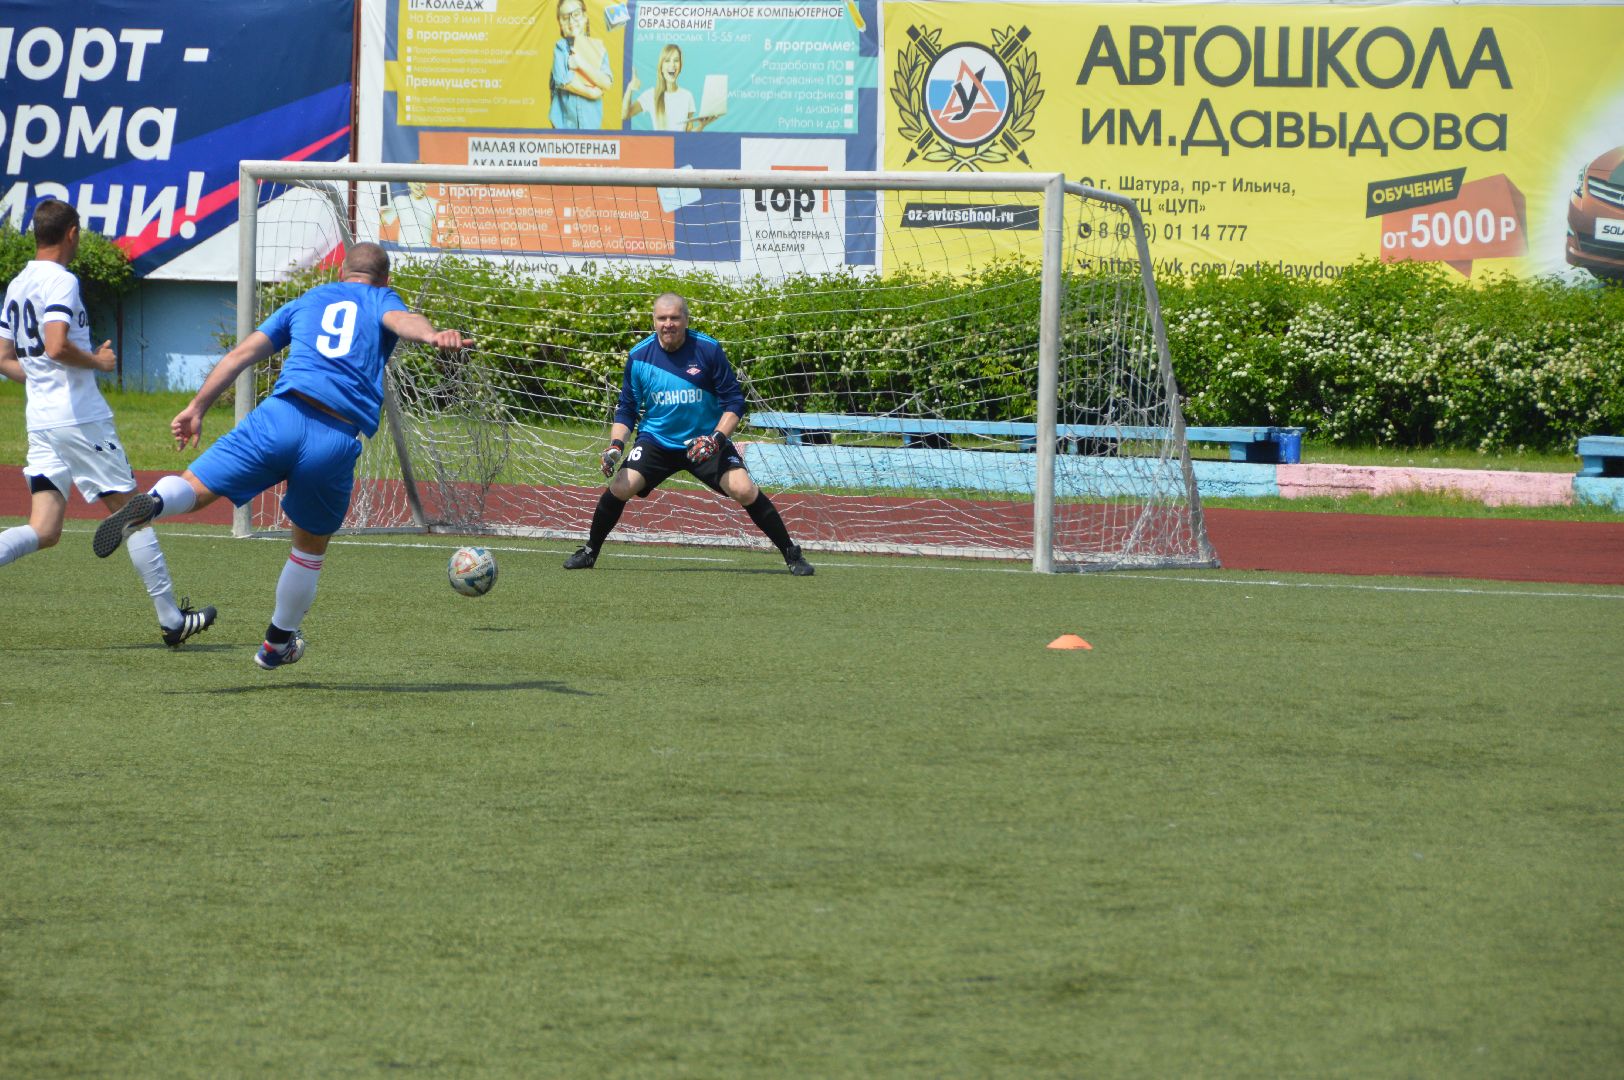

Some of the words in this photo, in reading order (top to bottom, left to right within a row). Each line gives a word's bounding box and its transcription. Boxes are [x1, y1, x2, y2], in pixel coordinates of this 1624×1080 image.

[484, 13, 494, 25] 11
[639, 6, 753, 17] ПРОФЕССИОНАЛЬНОЕ
[757, 7, 844, 18] КОМПЬЮТЕРНОЕ
[638, 19, 713, 29] ОБРАЗОВАНИЕ
[406, 28, 413, 40] В
[416, 30, 488, 43] программе:
[707, 32, 733, 42] 15-55
[764, 38, 771, 51] В
[775, 41, 855, 54] программе:
[1076, 25, 1513, 89] АВТОШКОЛА
[762, 59, 824, 72] Разработка
[827, 60, 844, 70] ПО
[406, 75, 502, 91] Преимущества:
[752, 74, 824, 86] Тестирование
[827, 75, 844, 85] ПО
[796, 89, 844, 102] графика
[805, 104, 843, 114] дизайн
[778, 116, 813, 129] Python
[1082, 98, 1508, 157] им.Давыдова
[0, 104, 177, 175] рма
[472, 141, 516, 153] МАЛАЯ
[519, 142, 617, 155] КОМПЬЮТЕРНАЯ
[450, 185, 528, 200] программе:
[1100, 179, 1112, 190] г.
[1119, 177, 1184, 198] Шатура,
[1192, 180, 1227, 198] пр-т
[1232, 178, 1296, 196] Ильича,
[1372, 177, 1454, 205] ОБУЧЕНИЕ
[446, 203, 554, 217] Программирование
[572, 207, 649, 219] Робототехника
[1158, 197, 1206, 215] «ЦУП»
[907, 207, 1015, 224] oz-avtoschool.ru
[755, 230, 830, 240] КОМПЬЮТЕРНАЯ
[1099, 222, 1108, 239] 8
[1116, 222, 1156, 243] (96)
[1164, 224, 1182, 241] 01
[1192, 224, 1210, 241] 14
[1217, 224, 1247, 242] 777
[1411, 208, 1496, 249] 5000
[500, 238, 517, 248] игр
[756, 243, 805, 253] АКАДЕМИЯ
[7, 298, 46, 358] 29
[316, 300, 358, 359] 9
